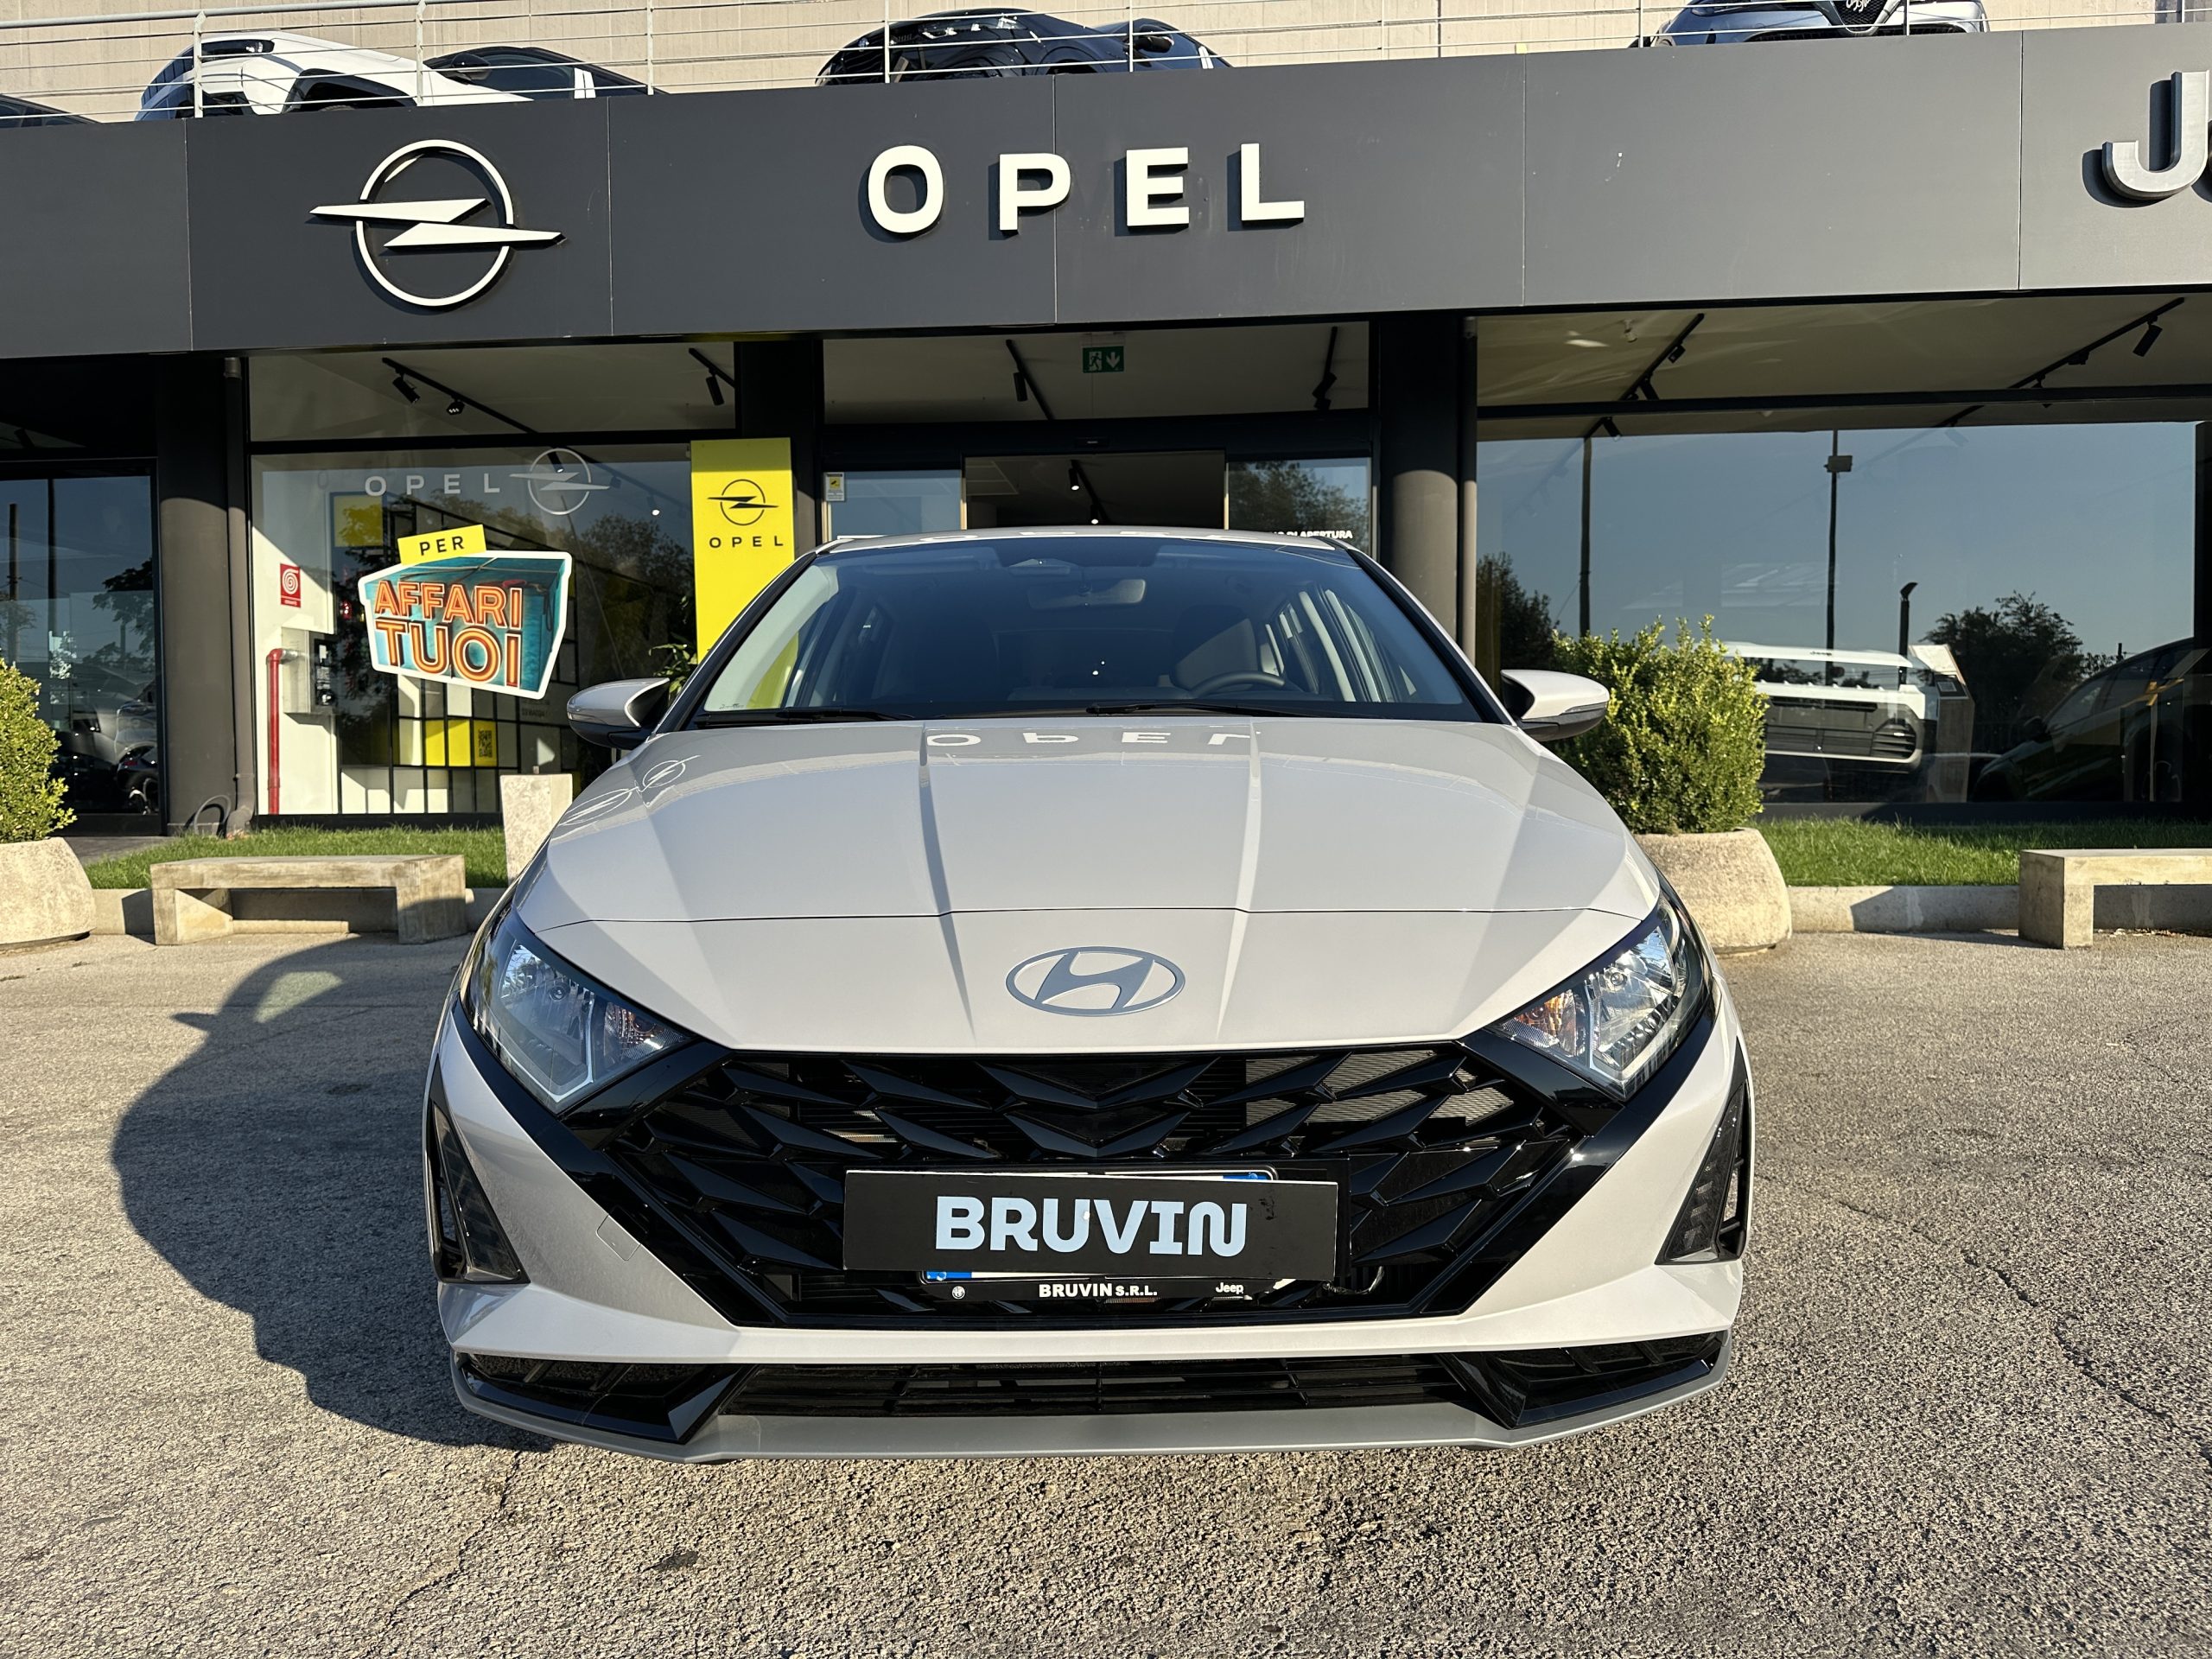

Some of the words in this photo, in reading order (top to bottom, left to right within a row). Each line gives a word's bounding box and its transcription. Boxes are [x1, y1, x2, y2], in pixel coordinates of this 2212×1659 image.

[2102, 70, 2212, 200] J
[868, 143, 1305, 233] OPEL
[365, 473, 501, 497] OPEL
[419, 535, 465, 556] PER
[709, 535, 784, 549] OPEL
[373, 579, 524, 630] AFFARI
[373, 618, 522, 689] TUOI
[935, 1196, 1248, 1257] BRUVIN
[1039, 1282, 1113, 1298] BRUVIN
[1115, 1284, 1158, 1297] S.R.L.
[1215, 1281, 1244, 1294] Jeep
